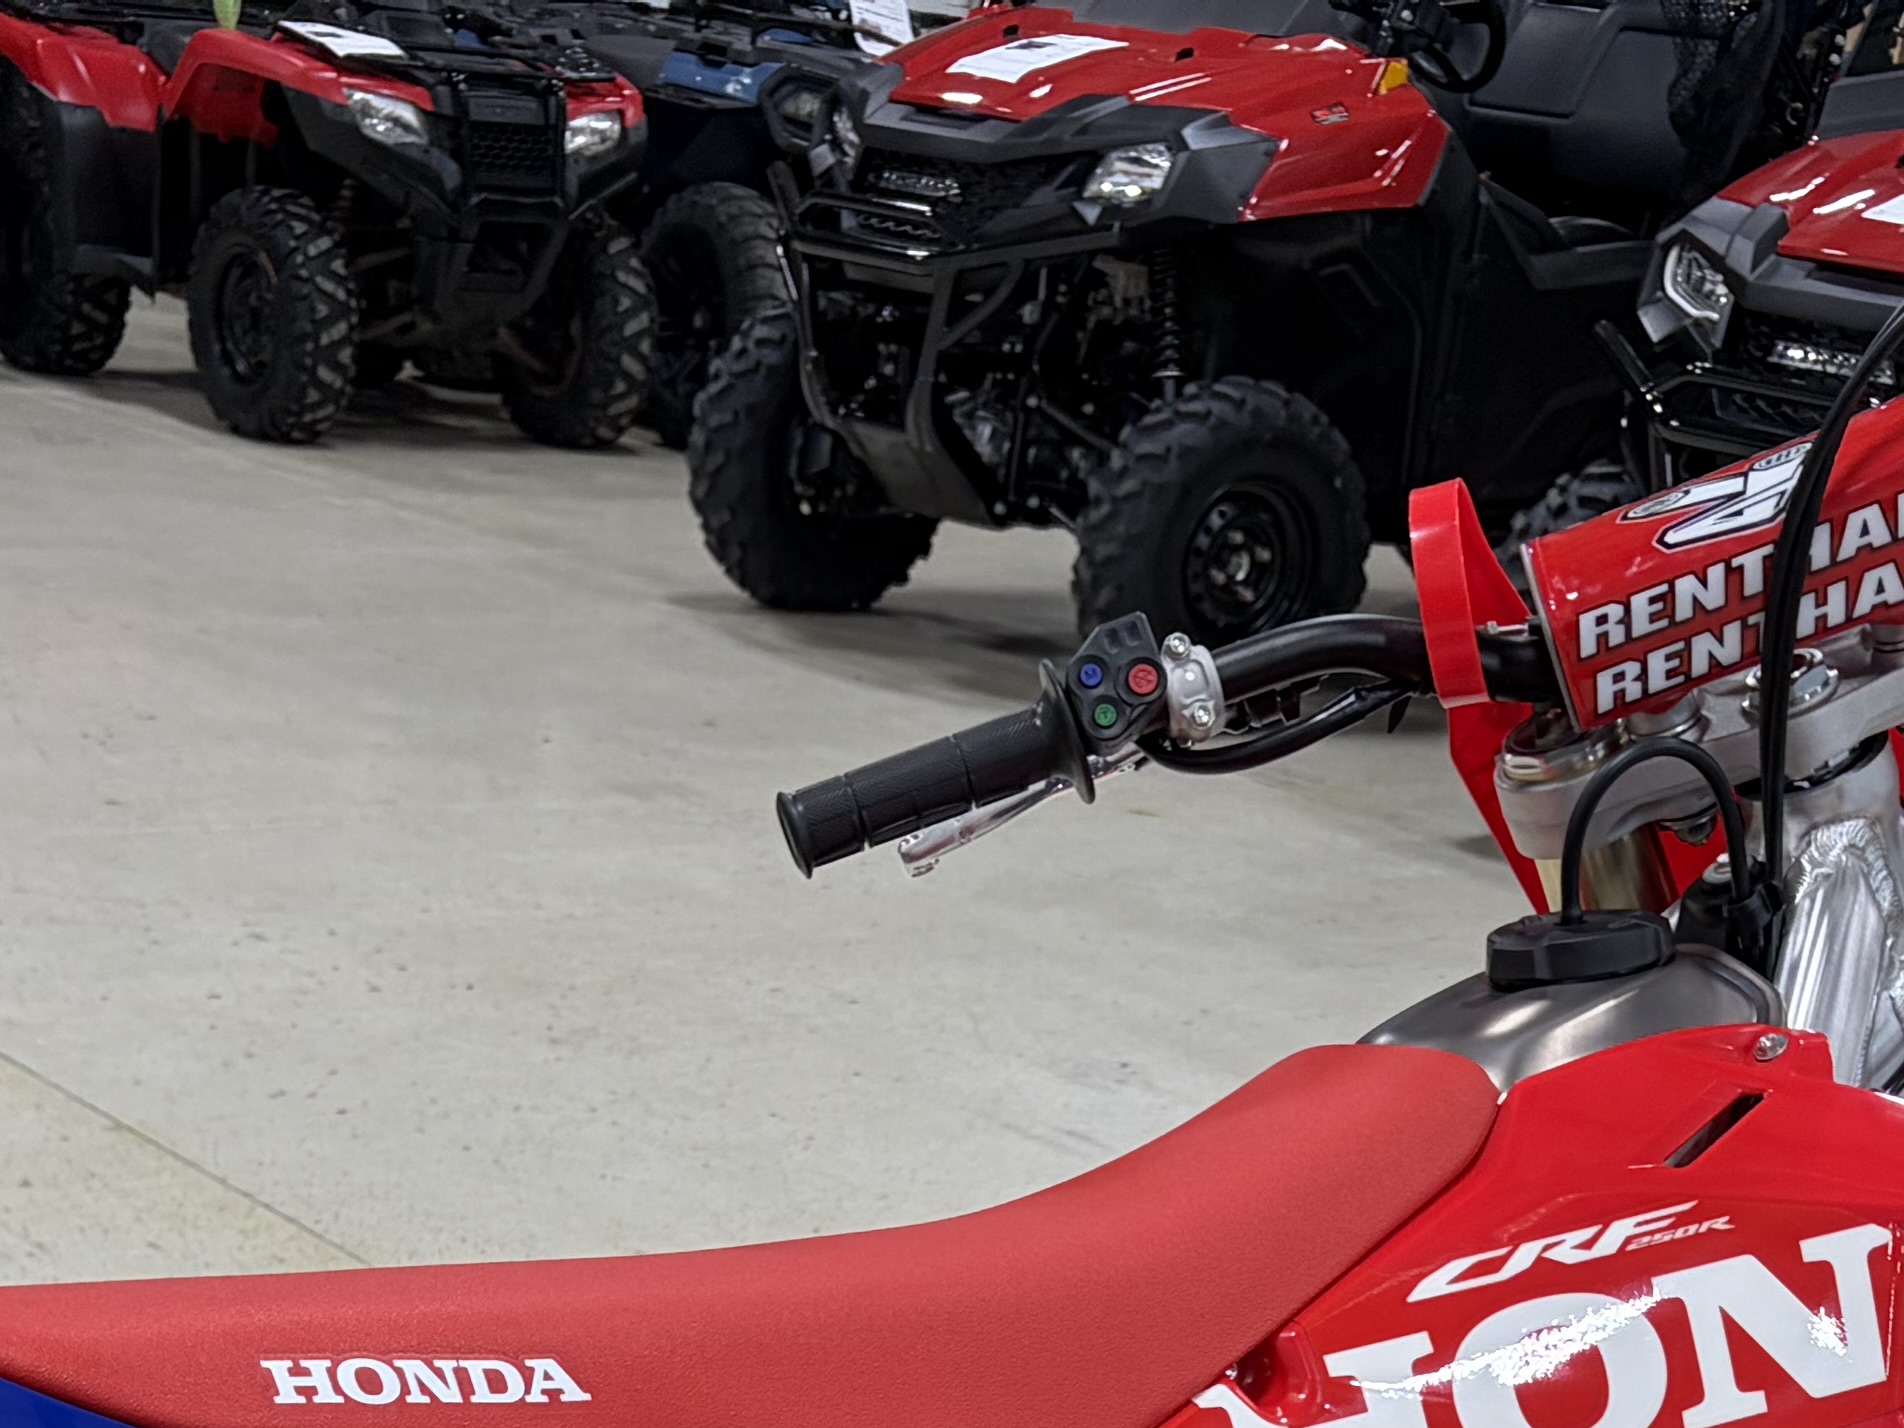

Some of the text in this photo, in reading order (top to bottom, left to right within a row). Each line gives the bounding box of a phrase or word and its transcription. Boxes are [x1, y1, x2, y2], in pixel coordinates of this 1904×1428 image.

[1406, 1199, 1736, 1303] CRF 250R
[259, 1357, 593, 1405] HONDA
